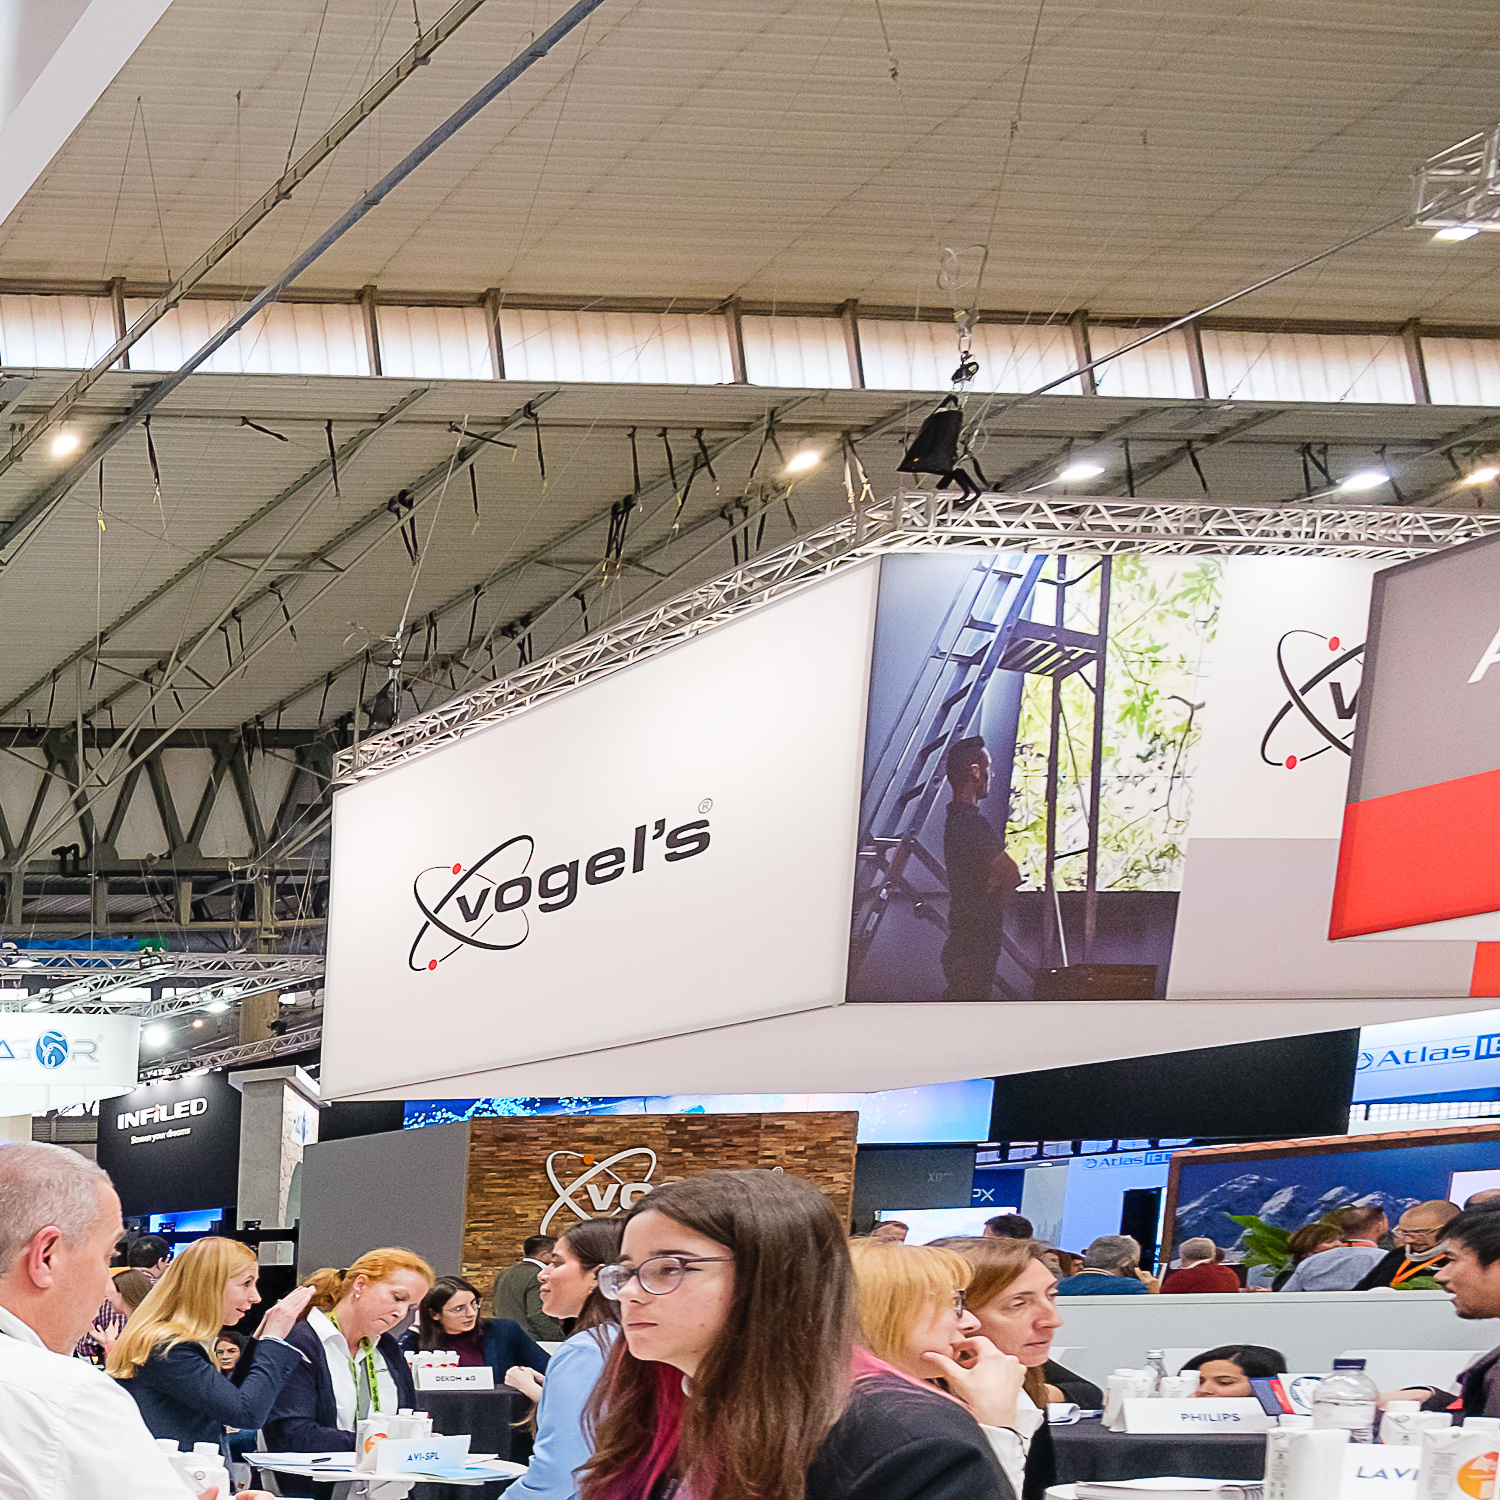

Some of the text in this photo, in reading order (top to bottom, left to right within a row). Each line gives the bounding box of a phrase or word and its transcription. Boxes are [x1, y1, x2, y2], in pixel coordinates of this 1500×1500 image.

[456, 818, 711, 923] vogel's
[1377, 1046, 1471, 1067] Atlas
[1180, 1413, 1241, 1422] PHILIPS
[407, 1452, 440, 1461] AVI-SPL
